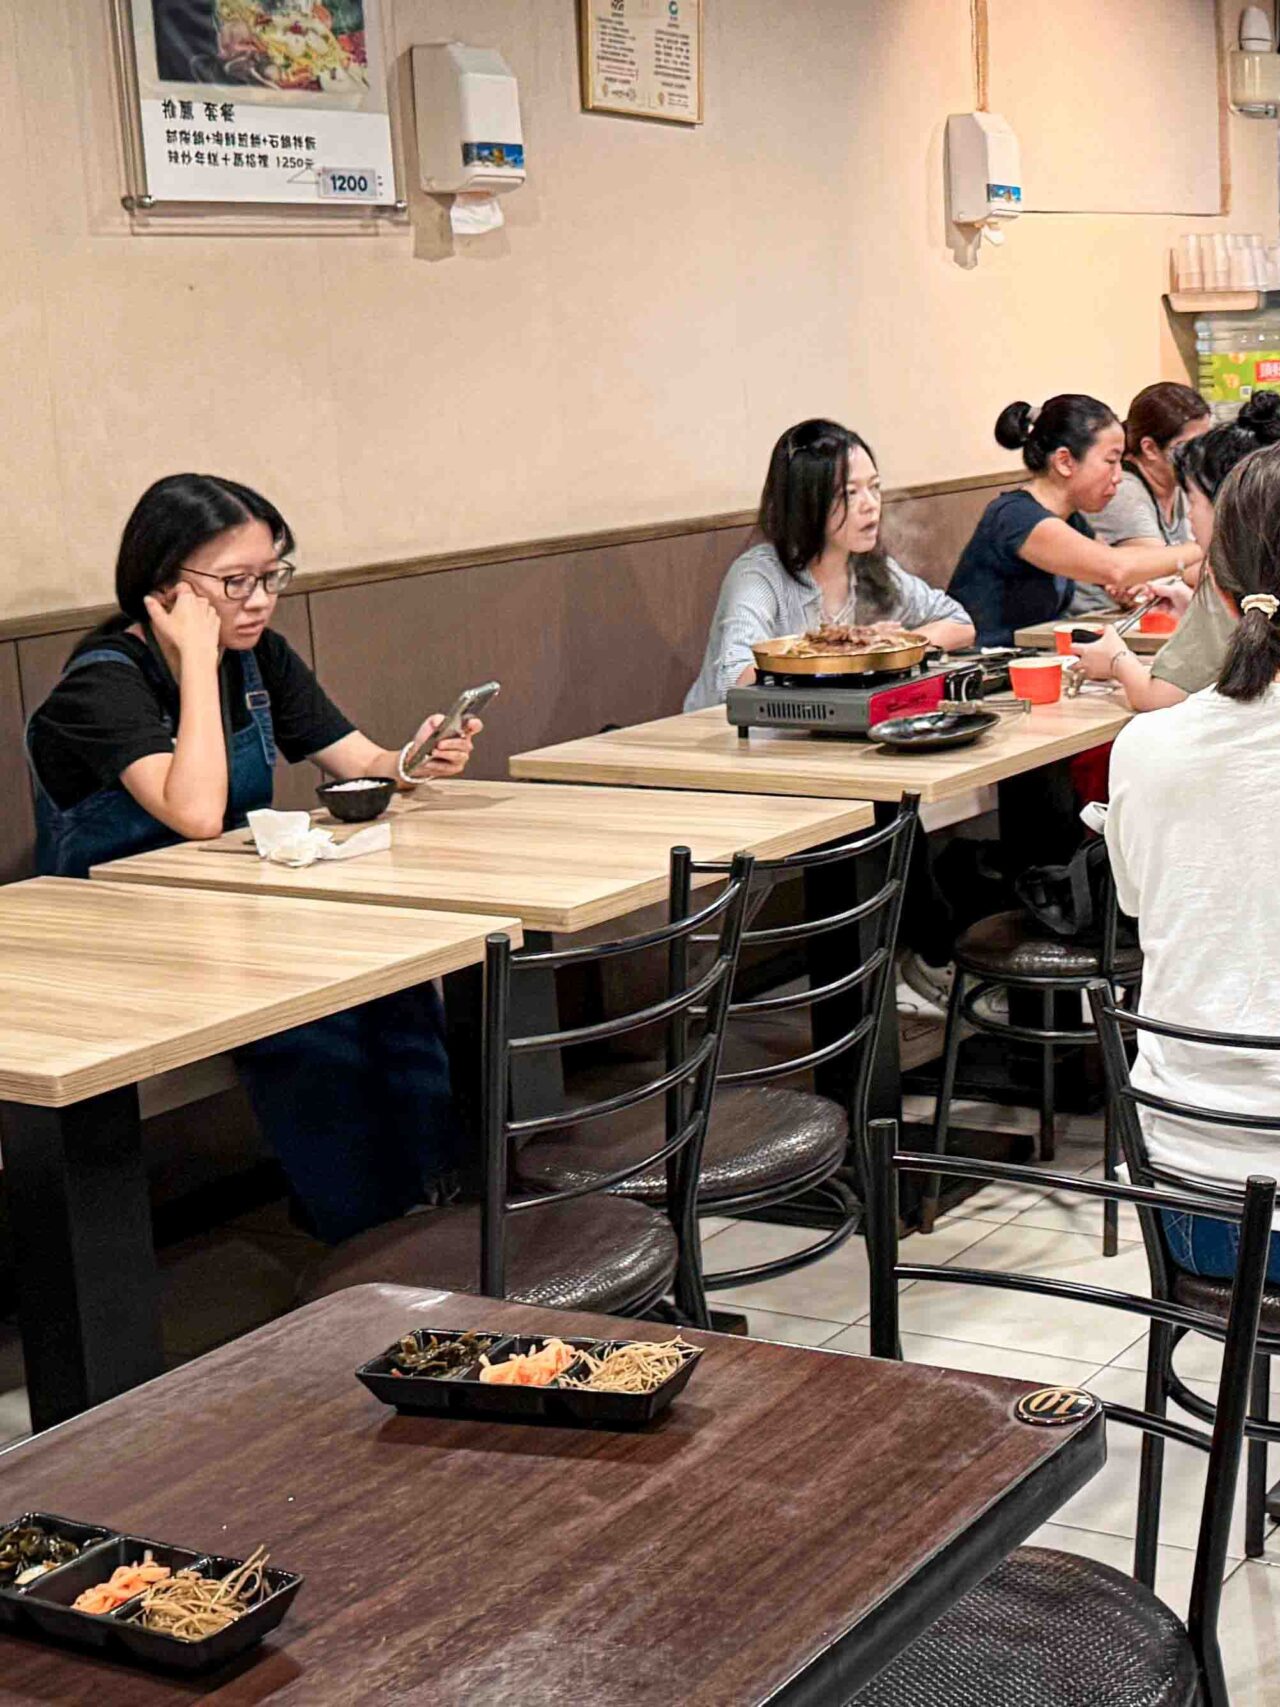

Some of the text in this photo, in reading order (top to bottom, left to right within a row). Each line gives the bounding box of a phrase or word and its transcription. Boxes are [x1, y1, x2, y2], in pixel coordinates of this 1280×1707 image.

[161, 99, 236, 123] 推薦 套餐
[276, 156, 316, 171] 1250元
[330, 174, 368, 192] 1200
